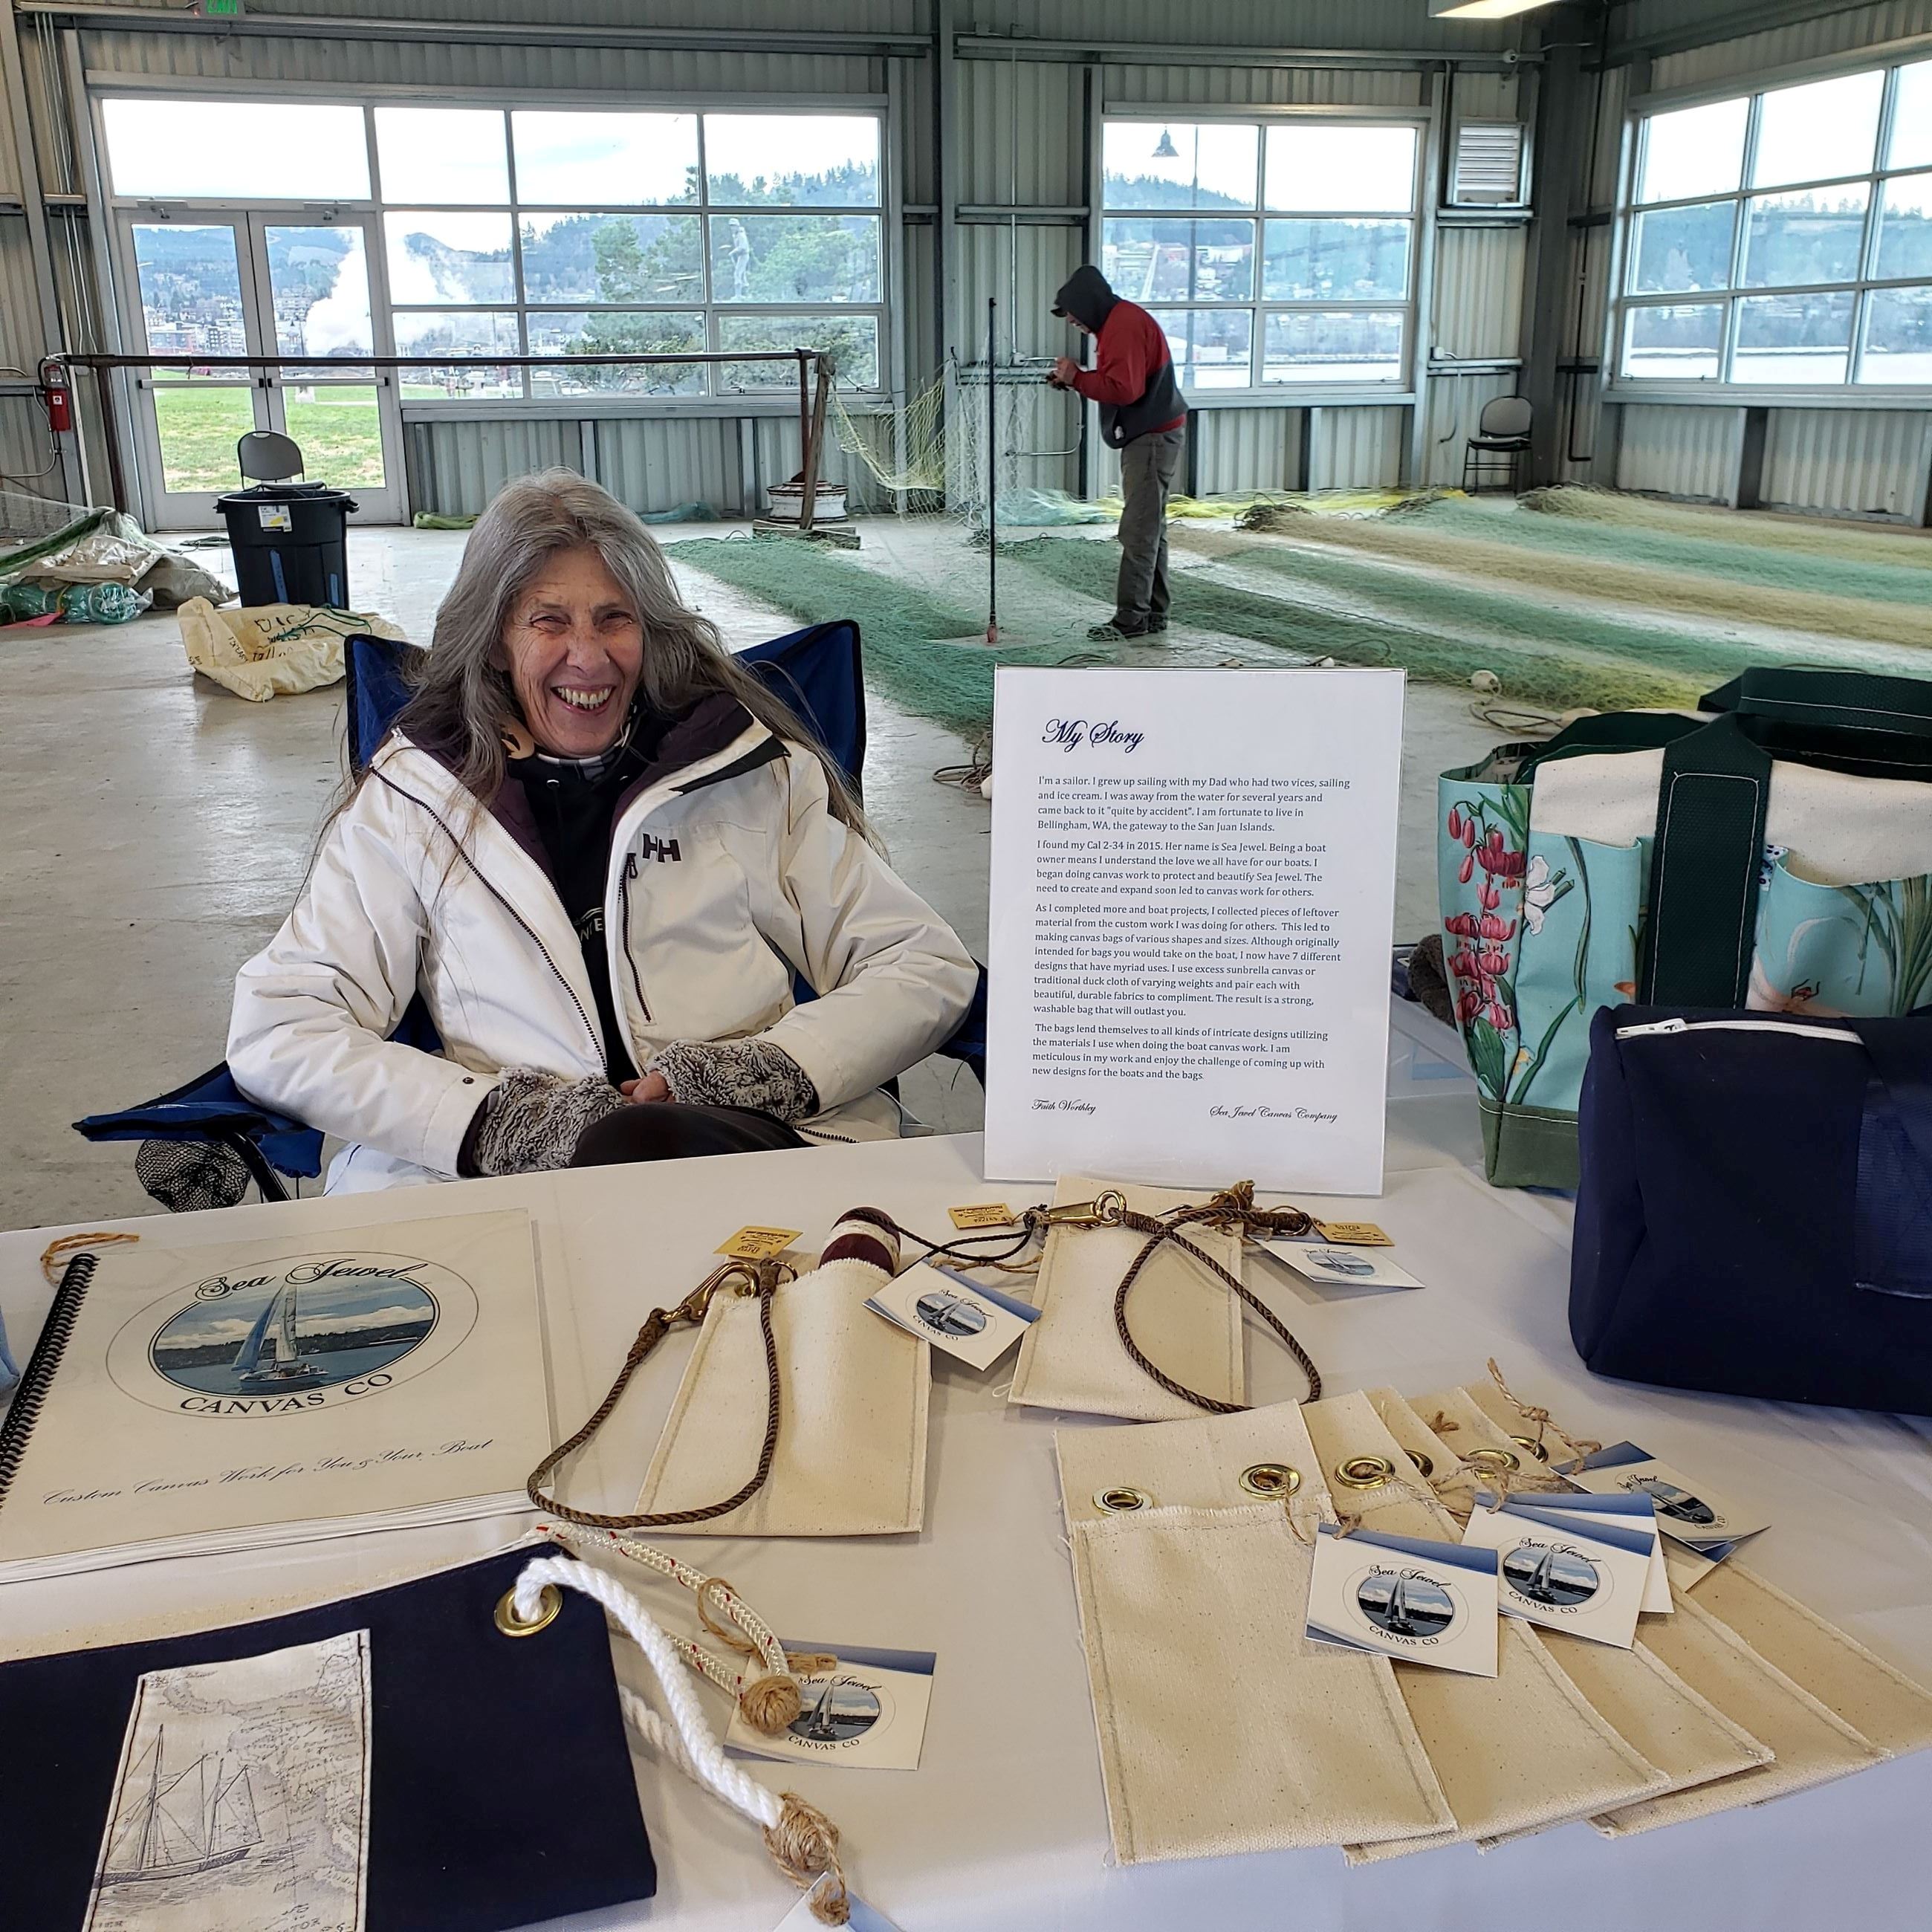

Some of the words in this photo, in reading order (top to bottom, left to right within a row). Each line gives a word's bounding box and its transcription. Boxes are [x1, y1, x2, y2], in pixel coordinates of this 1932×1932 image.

[1042, 719, 1088, 753] My
[1089, 720, 1144, 753] Story
[1039, 776, 1053, 785] I'm
[1062, 776, 1090, 785] sailor.
[1093, 777, 1095, 785] I
[1098, 779, 1121, 788] grew
[1124, 779, 1135, 788] up
[1137, 777, 1167, 788] sailing
[1169, 777, 1190, 786] with
[1192, 779, 1207, 788] my
[1209, 777, 1227, 786] Dad
[1229, 777, 1249, 787] who
[1251, 777, 1268, 787] had
[1291, 778, 1317, 788] vices,
[1318, 778, 1350, 790] sailing
[1038, 791, 1055, 800] and
[1057, 791, 1070, 800] ice
[1104, 791, 1108, 800] I
[1129, 794, 1155, 803] away
[1156, 791, 1178, 801] from
[1181, 791, 1196, 801] the
[1227, 792, 1240, 802] for
[1242, 792, 1276, 802] several
[1277, 795, 1303, 804] years
[1305, 793, 1323, 802] and
[1038, 820, 1090, 832] Bellingham,
[1092, 820, 1111, 831] WA,
[1113, 820, 1128, 830] the
[1129, 823, 1168, 832] gateway
[1170, 823, 1179, 831] to
[1181, 821, 1196, 831] the
[1198, 822, 1214, 831] San
[1216, 822, 1237, 833] Juan
[1239, 822, 1274, 832] Islands.
[642, 833, 682, 863] HH
[1037, 840, 1040, 849] I
[1043, 840, 1069, 849] found
[1071, 843, 1086, 852] my
[1087, 840, 1100, 850] Cal
[1103, 841, 1124, 850] 2-34
[1127, 841, 1135, 850] in
[1137, 841, 1164, 851] 2015.
[1165, 842, 1182, 851] Her
[1211, 842, 1220, 851] is
[1221, 843, 1237, 852] Sea
[1239, 843, 1268, 853] Jewel.
[1269, 843, 1296, 855] Being
[1306, 843, 1326, 852] boat
[1037, 869, 1063, 881] began
[1065, 869, 1091, 881] doing
[1125, 870, 1150, 880] work
[1151, 872, 1161, 880] to
[1162, 872, 1196, 882] protect
[1197, 871, 1215, 881] and
[1217, 872, 1255, 883] beautify
[1256, 872, 1272, 881] Sea
[1274, 872, 1302, 884] Jewel.
[1304, 872, 1323, 882] The
[1035, 904, 1047, 912] As
[1049, 904, 1051, 912] I
[1054, 904, 1100, 915] completed
[1129, 905, 1146, 914] and
[1148, 905, 1169, 915] boat
[1170, 906, 1209, 917] projects,
[1211, 906, 1215, 915] I
[1217, 907, 1258, 915] collected
[1260, 907, 1289, 918] pieces
[1291, 907, 1302, 916] of
[1303, 907, 1340, 917] leftover
[1035, 931, 1069, 944] making
[1102, 933, 1123, 944] bags
[1125, 933, 1135, 943] of
[1135, 934, 1170, 944] various
[1171, 935, 1203, 946] shapes
[1205, 936, 1222, 944] and
[1223, 936, 1248, 945] sizes.
[1251, 936, 1293, 948] Although
[1295, 937, 1340, 951] originally
[1034, 989, 1075, 1000] beautiful,
[1077, 991, 1112, 1000] durable
[1114, 991, 1144, 1001] fabrics
[1147, 993, 1155, 1001] to
[1157, 993, 1213, 1004] compliment.
[1215, 993, 1234, 1003] The
[1235, 994, 1262, 1003] result
[1265, 995, 1272, 1004] is
[1281, 996, 1314, 1007] strong,
[1034, 1023, 1052, 1032] The
[1054, 1023, 1074, 1034] bags
[1076, 1024, 1096, 1034] lend
[1098, 1025, 1149, 1035] themselves
[1161, 1026, 1173, 1036] all
[1175, 1027, 1199, 1036] kinds
[1202, 1028, 1212, 1037] of
[1213, 1028, 1251, 1038] intricate
[1253, 1029, 1288, 1040] designs
[1290, 1030, 1328, 1042] utilizing
[1031, 1099, 1055, 1110] Faith
[1209, 1105, 1228, 1117] Sea
[1258, 1106, 1291, 1118] Canvas
[1295, 1107, 1338, 1124] Company
[195, 1276, 277, 1301] Sea
[285, 1258, 429, 1285] Jewel
[180, 1393, 325, 1413] CANVAS
[344, 1374, 393, 1395] CO
[42, 1488, 122, 1505] Custom
[132, 1478, 209, 1494] Canvas
[218, 1465, 276, 1484] Work
[268, 1462, 304, 1482] for
[314, 1456, 353, 1472] You
[1519, 1537, 1548, 1549] Sea
[1369, 1564, 1397, 1578] Sea
[1399, 1568, 1451, 1588] Jewel
[1508, 1591, 1555, 1612] CANVAS
[1369, 1625, 1417, 1646] CANVAS
[1422, 1637, 1439, 1646] CO
[831, 1674, 883, 1691] Jewel
[788, 1735, 837, 1751] CANVAS
[842, 1739, 860, 1748] CO
